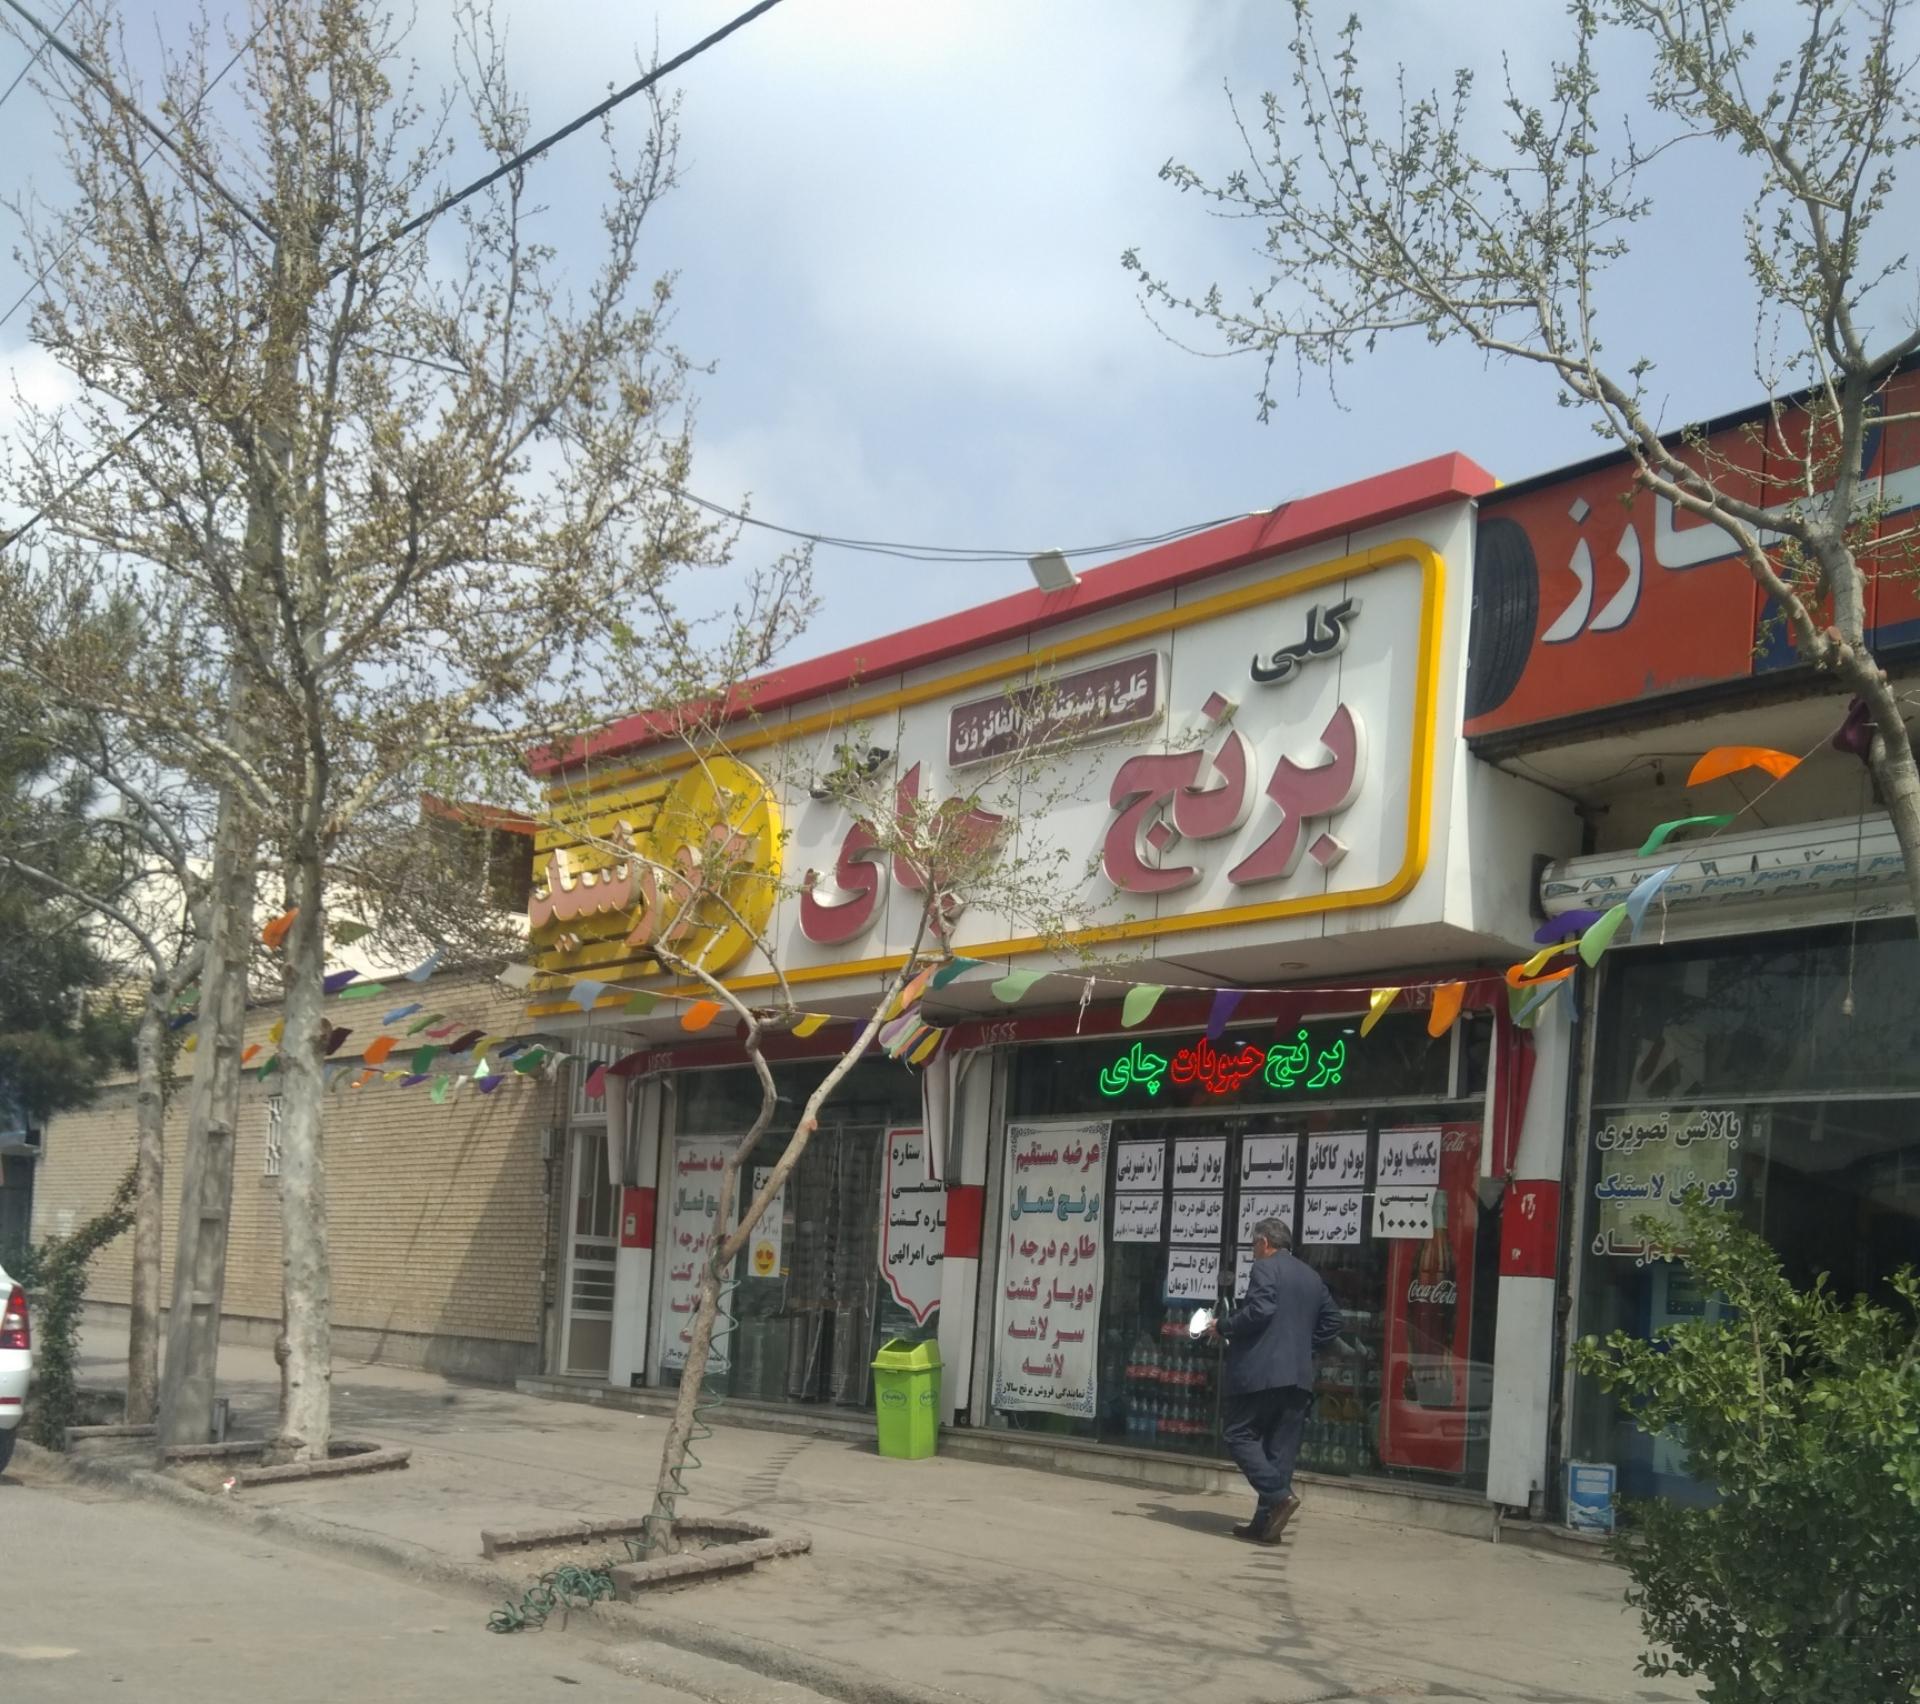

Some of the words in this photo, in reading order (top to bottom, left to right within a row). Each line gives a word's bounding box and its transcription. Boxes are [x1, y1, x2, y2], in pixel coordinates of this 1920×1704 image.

[1248, 597, 1362, 684] کلی
[1102, 690, 1366, 894] برنج
[1099, 1041, 1167, 1096] چای
[1171, 1037, 1264, 1094] حبوبات
[1264, 1029, 1345, 1089] برنج
[1596, 1111, 1670, 1155] تصویری
[1673, 1110, 1741, 1149] بالانس
[1016, 1140, 1059, 1174] مستقیم
[1062, 1138, 1100, 1173] عرضه
[1010, 1185, 1055, 1221] شمال
[1057, 1184, 1100, 1222] برنج
[1595, 1172, 1667, 1209] لاستیک
[1020, 1238, 1057, 1266] درجه
[1059, 1233, 1097, 1266] طارم
